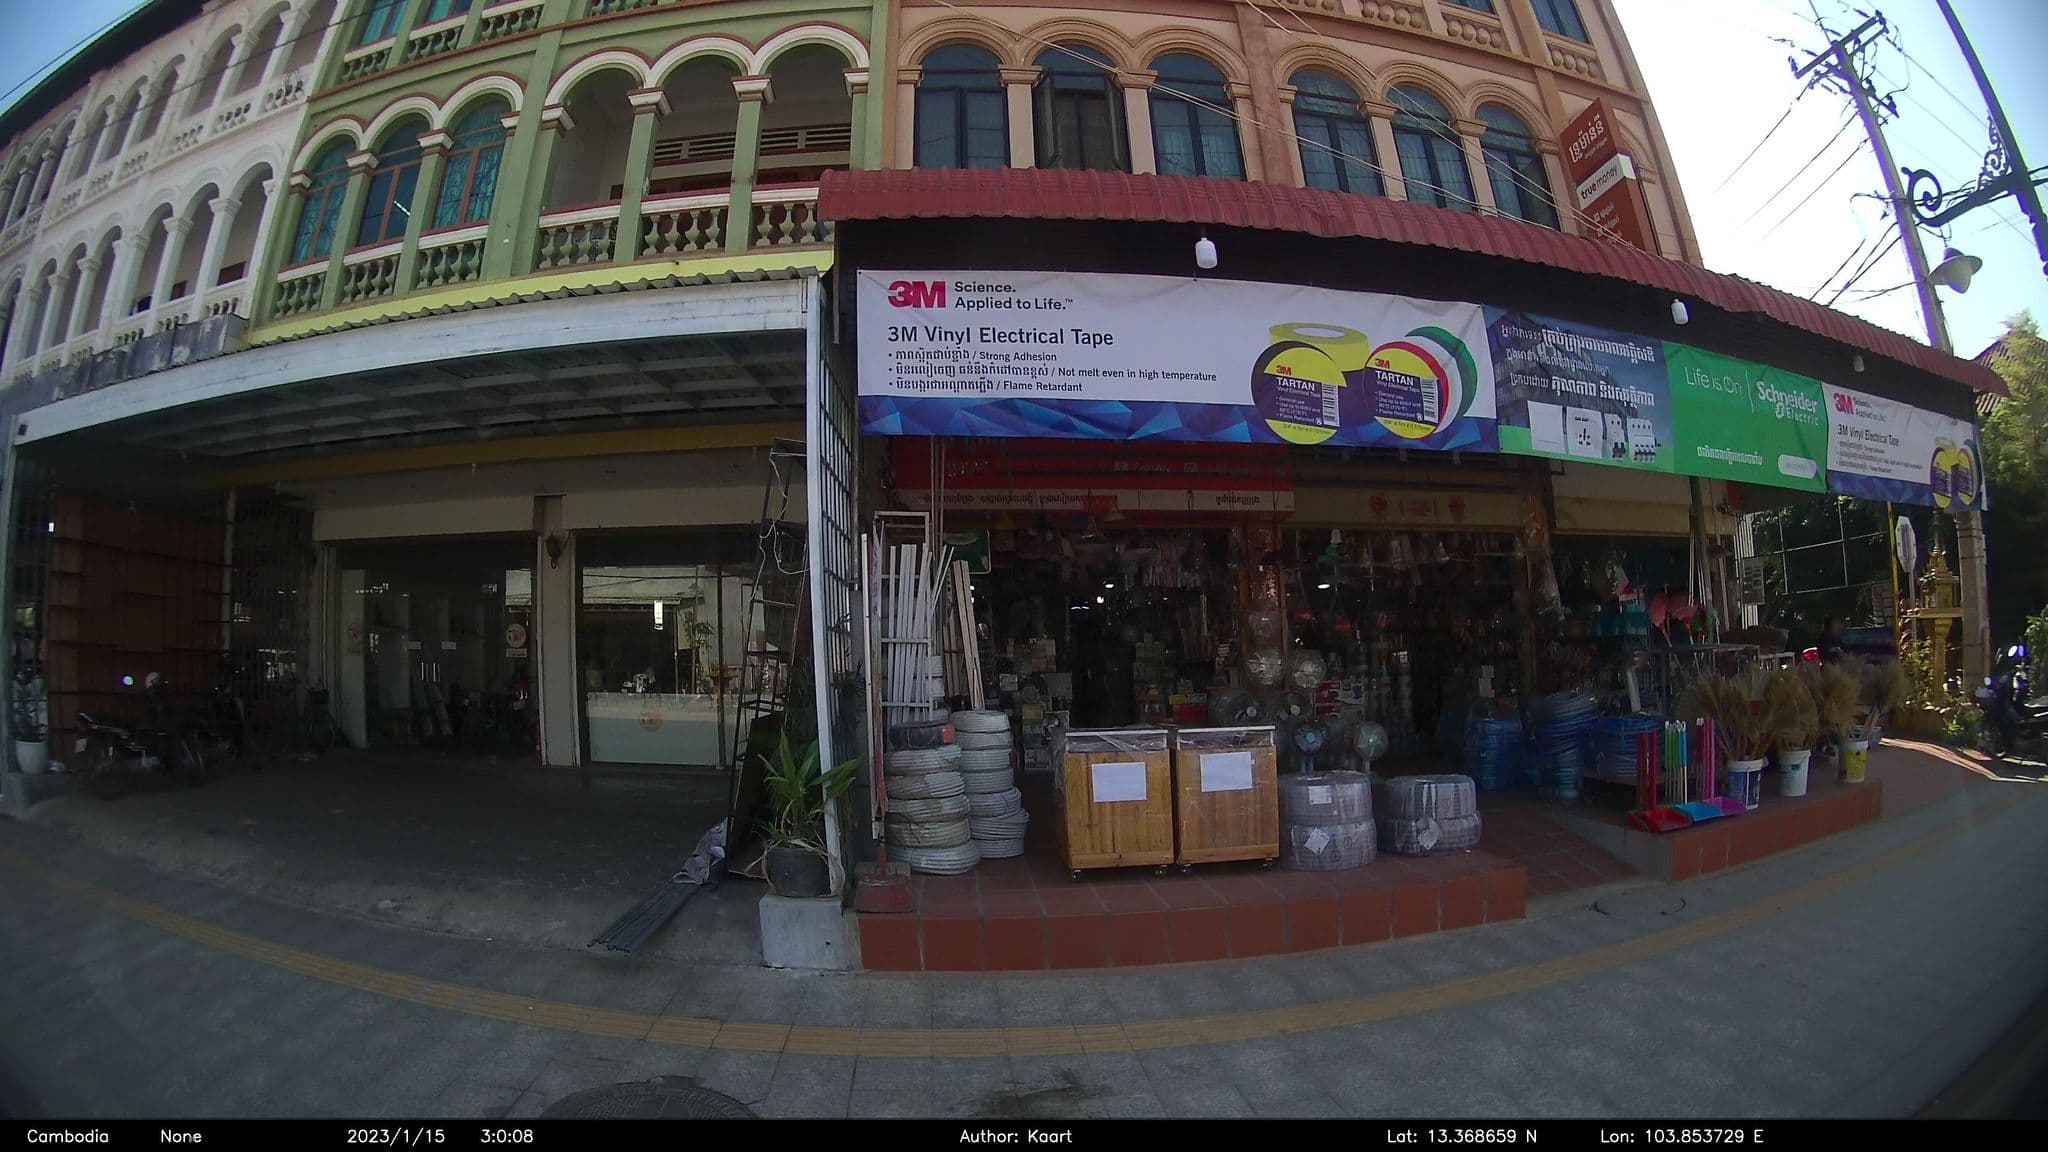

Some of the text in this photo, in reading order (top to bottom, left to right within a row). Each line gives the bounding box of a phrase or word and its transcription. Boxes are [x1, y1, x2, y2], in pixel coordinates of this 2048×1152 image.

[954, 281, 1016, 292] Science.
[887, 281, 946, 308] 3M
[955, 297, 1011, 311] Applied
[1016, 299, 1031, 309] to
[888, 326, 1114, 348] 3M Vinyl Electrical Tape
[979, 351, 1010, 362] Strong
[1013, 352, 1057, 361] Adhesion
[1375, 358, 1390, 369] 3M
[1058, 367, 1075, 378] Not
[1078, 368, 1099, 378] melt
[1102, 370, 1124, 379] even
[1127, 369, 1136, 379] in
[1139, 369, 1159, 381] high
[1161, 370, 1217, 382] temperature
[1276, 365, 1292, 376] 3M
[1375, 370, 1414, 386] TARTAN
[1003, 380, 1033, 390] Flame
[1036, 381, 1083, 392] Retardant
[1276, 377, 1315, 391] TARTAN
[1685, 366, 1710, 389] Life
[1723, 376, 1742, 396] On
[1756, 380, 1817, 413] Schneider
[1833, 392, 1854, 415] 3M
[1786, 407, 1819, 426] Electric
[1837, 424, 1849, 436] 3M
[1849, 425, 1863, 441] Vinyl
